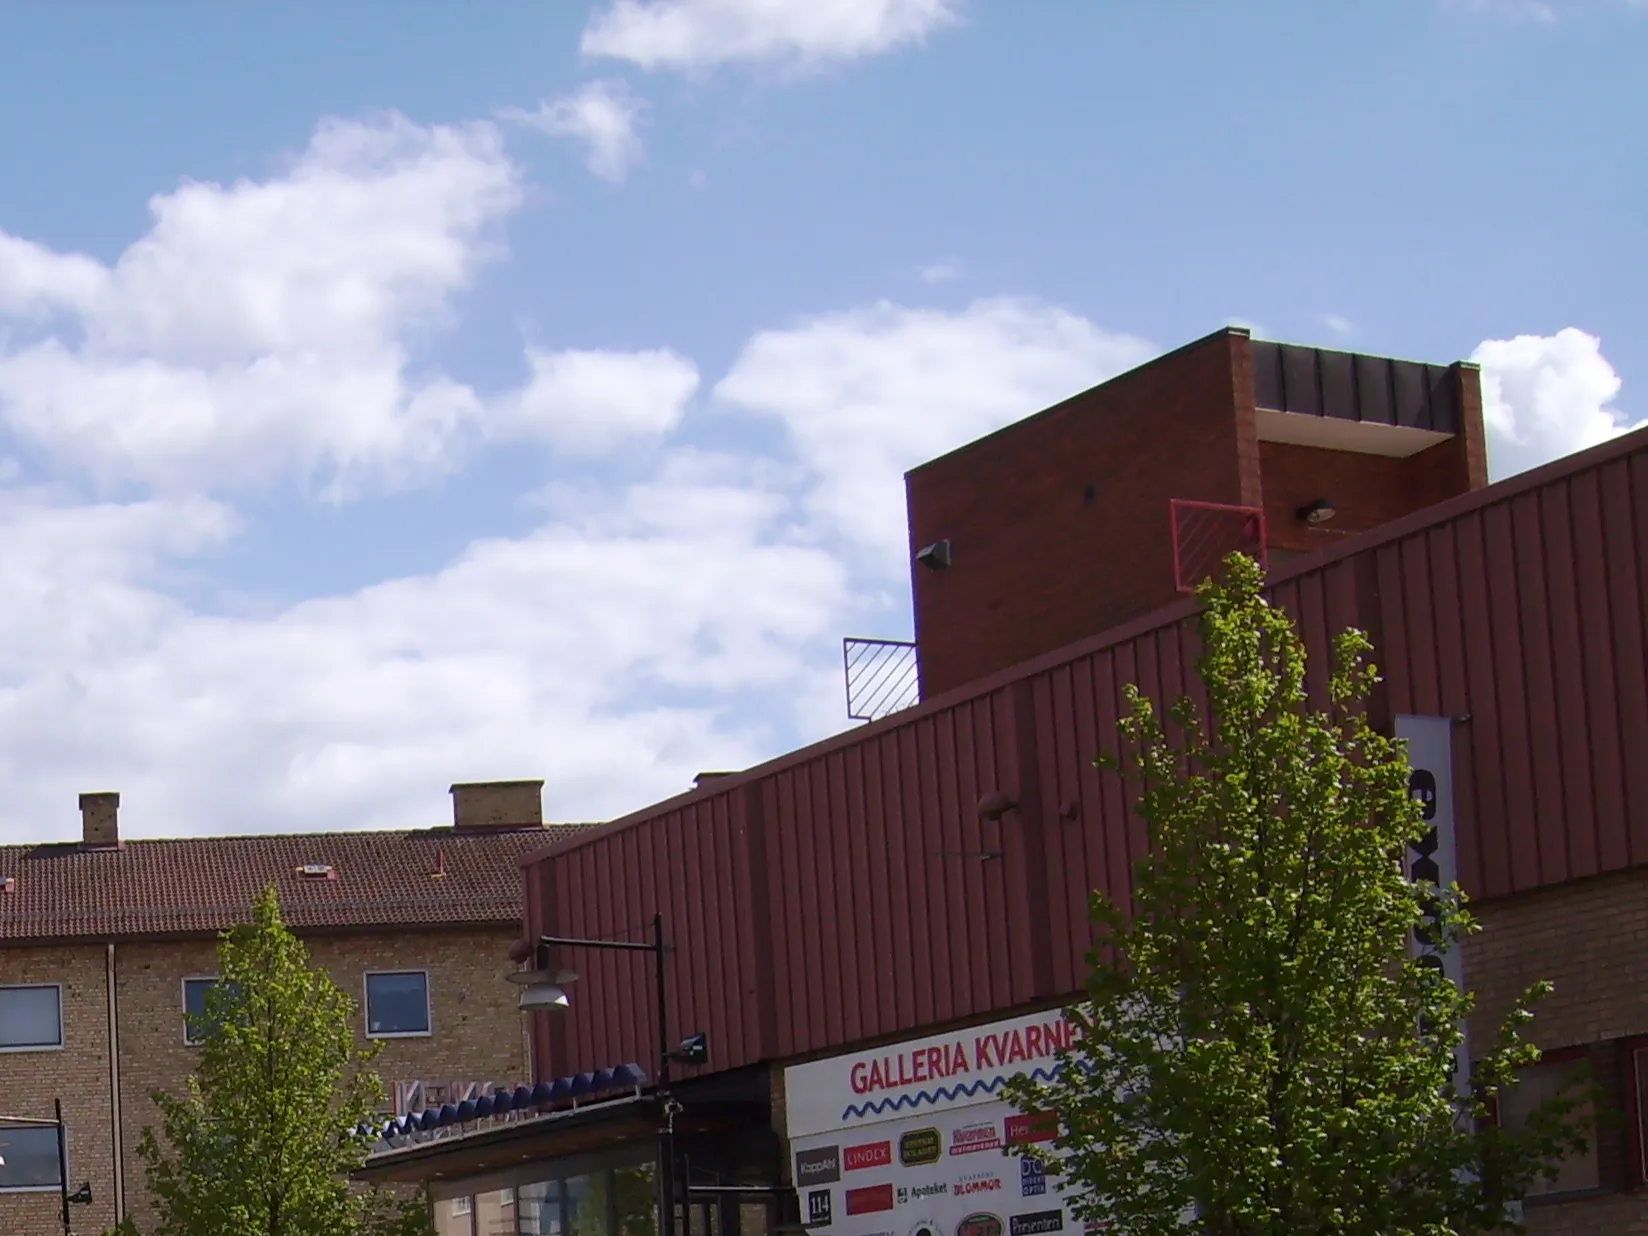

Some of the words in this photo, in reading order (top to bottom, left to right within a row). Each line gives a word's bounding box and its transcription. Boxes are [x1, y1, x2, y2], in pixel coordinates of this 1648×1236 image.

[849, 1041, 970, 1096] GALLERIA
[847, 1147, 886, 1166] LINDEX
[800, 1158, 837, 1175] KappAhl
[911, 1183, 947, 1199] Apoteket
[953, 1178, 1002, 1196] BLOMMOR
[811, 1195, 829, 1214] 114
